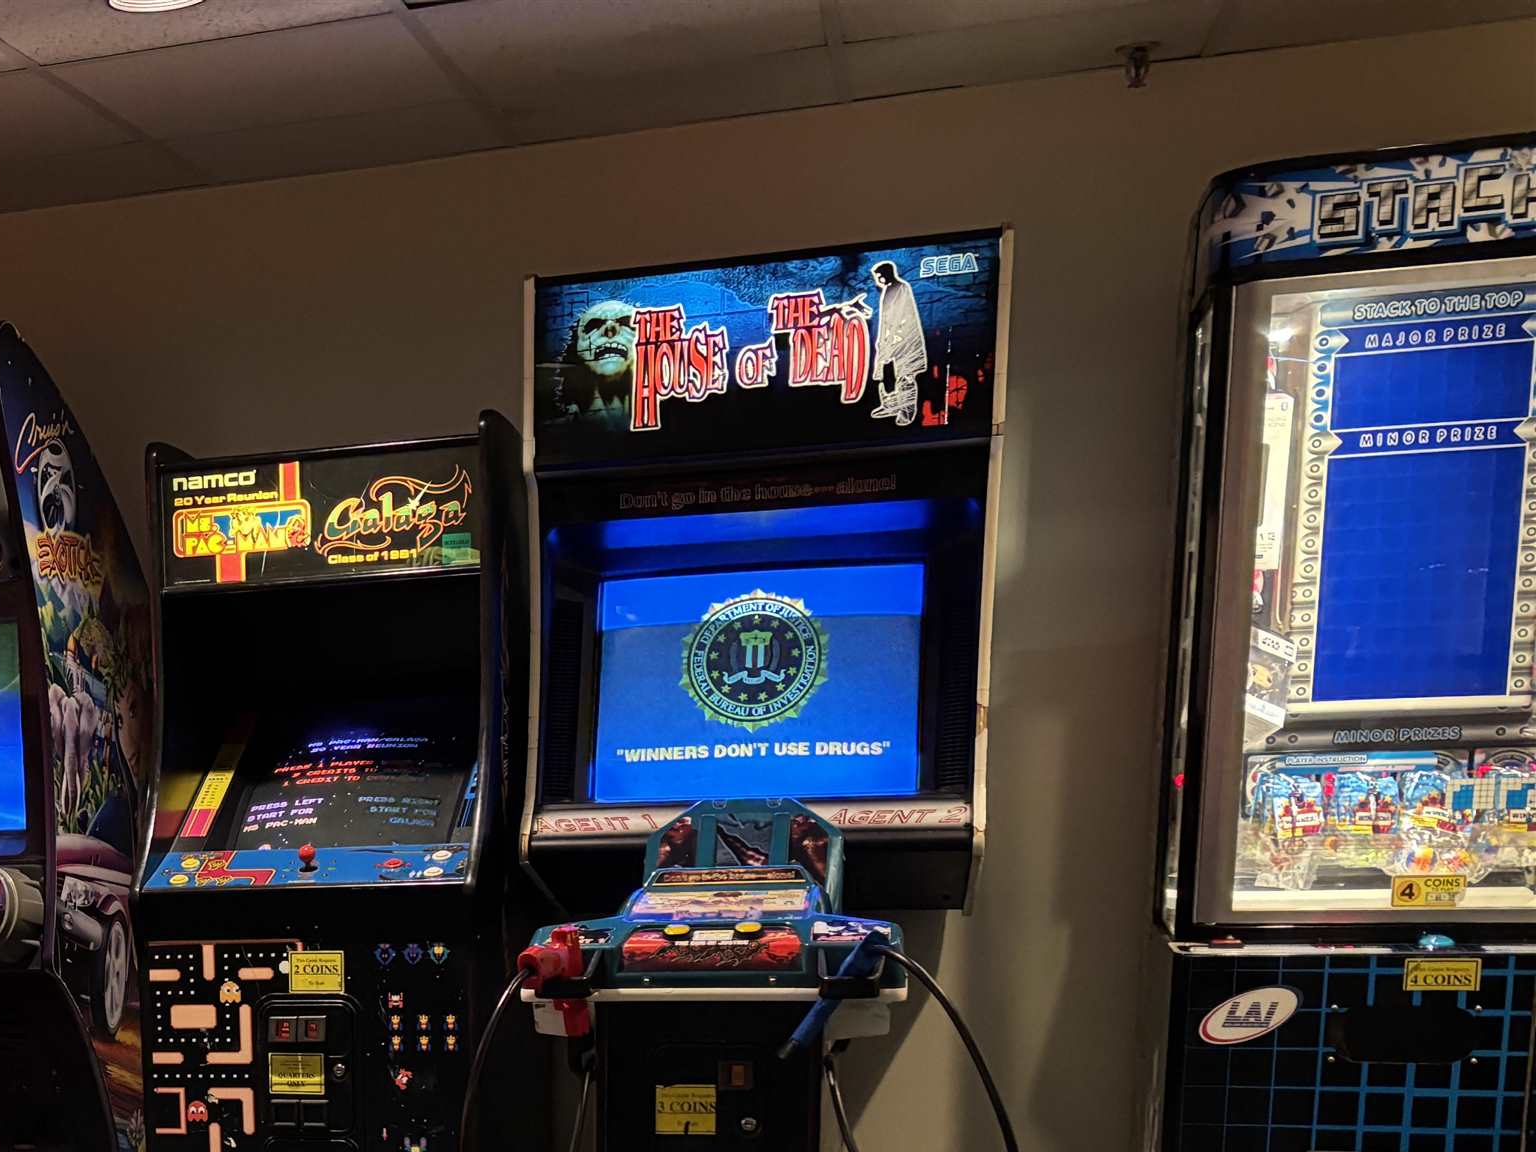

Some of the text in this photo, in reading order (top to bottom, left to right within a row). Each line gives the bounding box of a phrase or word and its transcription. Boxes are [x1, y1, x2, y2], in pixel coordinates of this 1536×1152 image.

[921, 253, 979, 277] SEGA
[1353, 290, 1523, 320] STACK TO THE TOP
[1364, 323, 1506, 348] MAJOR PRIZE
[631, 288, 870, 431] THE HOUSE OF THE DEAD
[1359, 425, 1497, 447] MINOR PRIZE
[173, 471, 256, 491] namco
[174, 491, 278, 506] 20 Year Reunion
[619, 491, 668, 509] Don't
[671, 493, 696, 510] go
[698, 488, 716, 504] in
[720, 486, 752, 503] the
[321, 480, 469, 552] Galaga
[184, 524, 288, 555] PAC-MAN
[328, 549, 417, 565] Class of 1981
[701, 602, 812, 645] DEPARTMENT OF JUSTICE
[694, 645, 816, 716] FEDERAL BUREAU OF INVESTIGATION
[1332, 726, 1463, 744] MINOR PRIZES
[617, 740, 891, 763] "WINNERS DON'T USE DRUGS"
[250, 797, 324, 812] PRESS LEFT
[358, 796, 395, 804] PRESS
[247, 808, 314, 822] START FOR
[369, 806, 407, 814] START
[829, 806, 967, 825] AGENT 2
[265, 817, 318, 829] PAC-MAN
[642, 813, 659, 829] 1
[1400, 883, 1415, 899] 4
[1424, 879, 1461, 888] COINS
[294, 964, 339, 975] 2 COINS
[1409, 975, 1473, 985] 4 COINS
[287, 1079, 305, 1087] ONLY
[657, 1101, 717, 1113] 3 COINS
